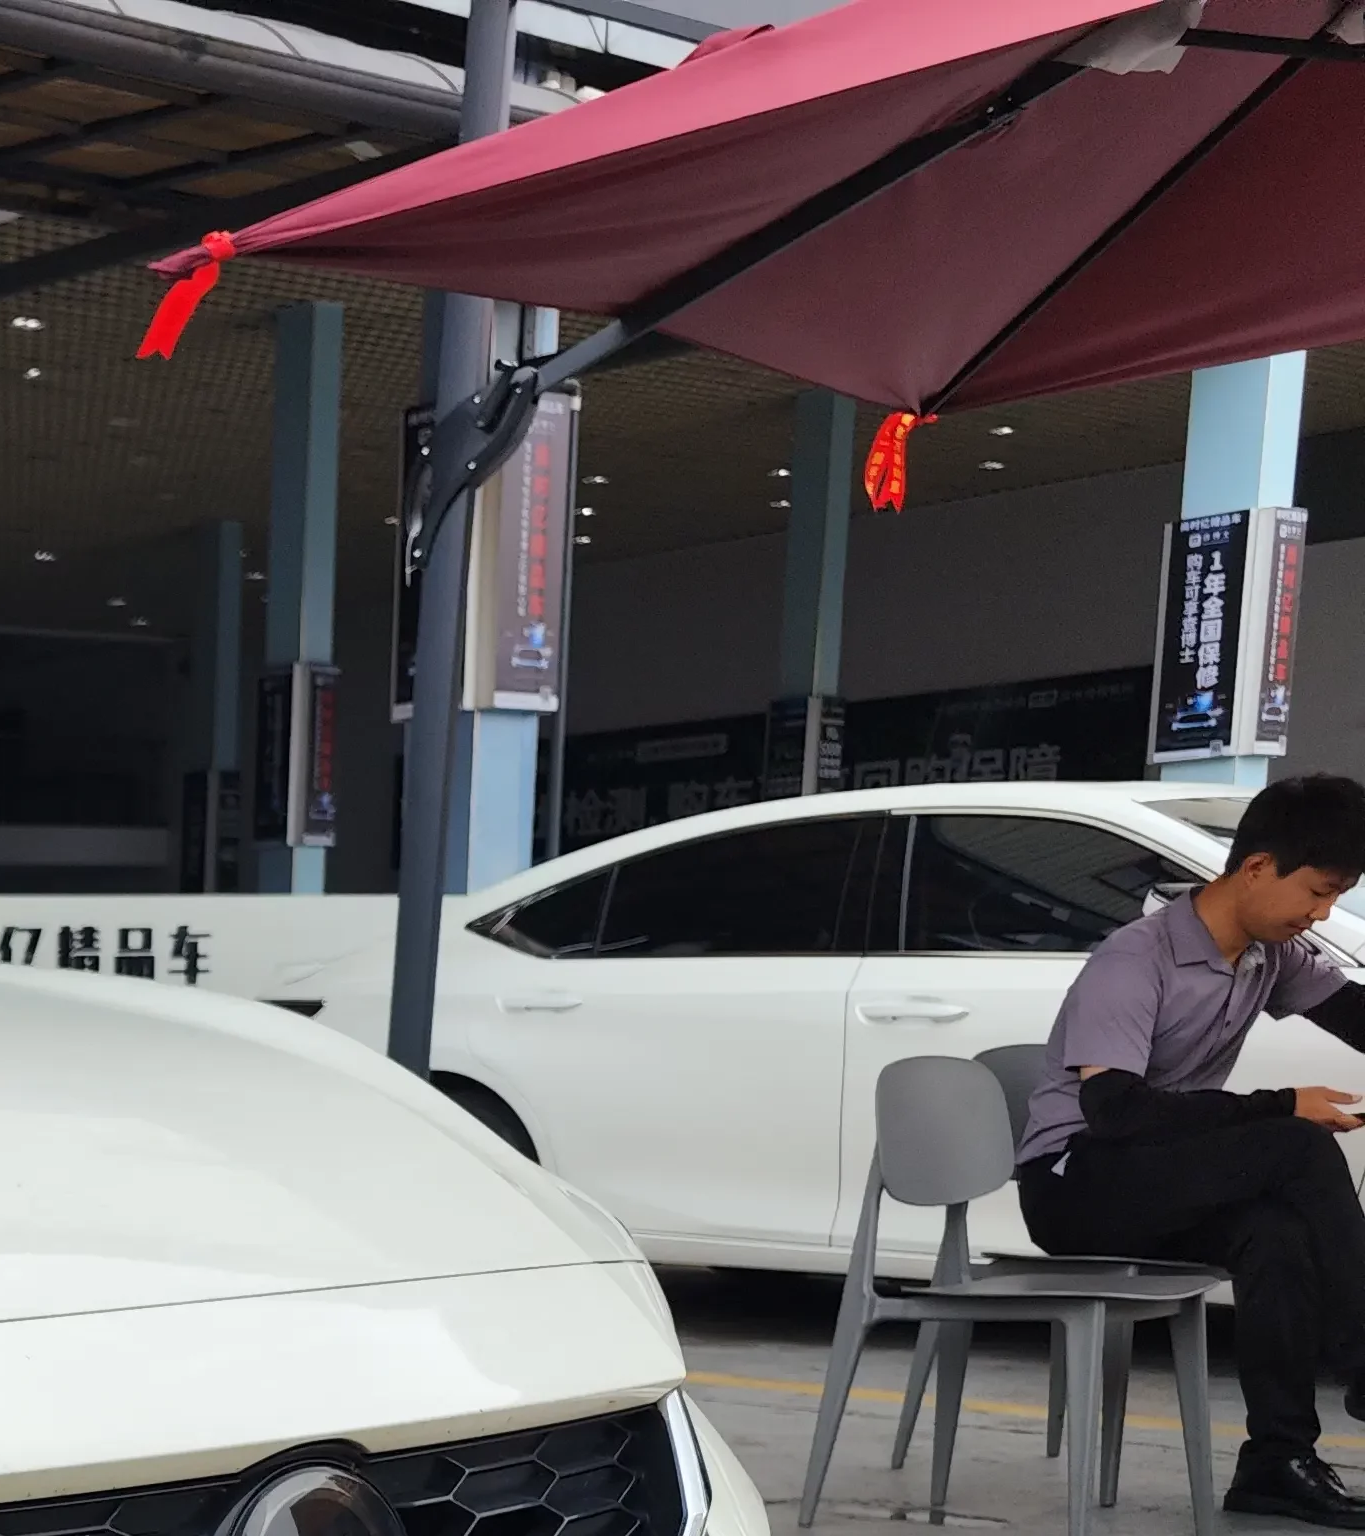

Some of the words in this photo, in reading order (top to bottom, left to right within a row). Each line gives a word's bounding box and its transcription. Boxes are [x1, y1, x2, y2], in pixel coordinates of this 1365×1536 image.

[1195, 550, 1226, 691] 1年全国保修
